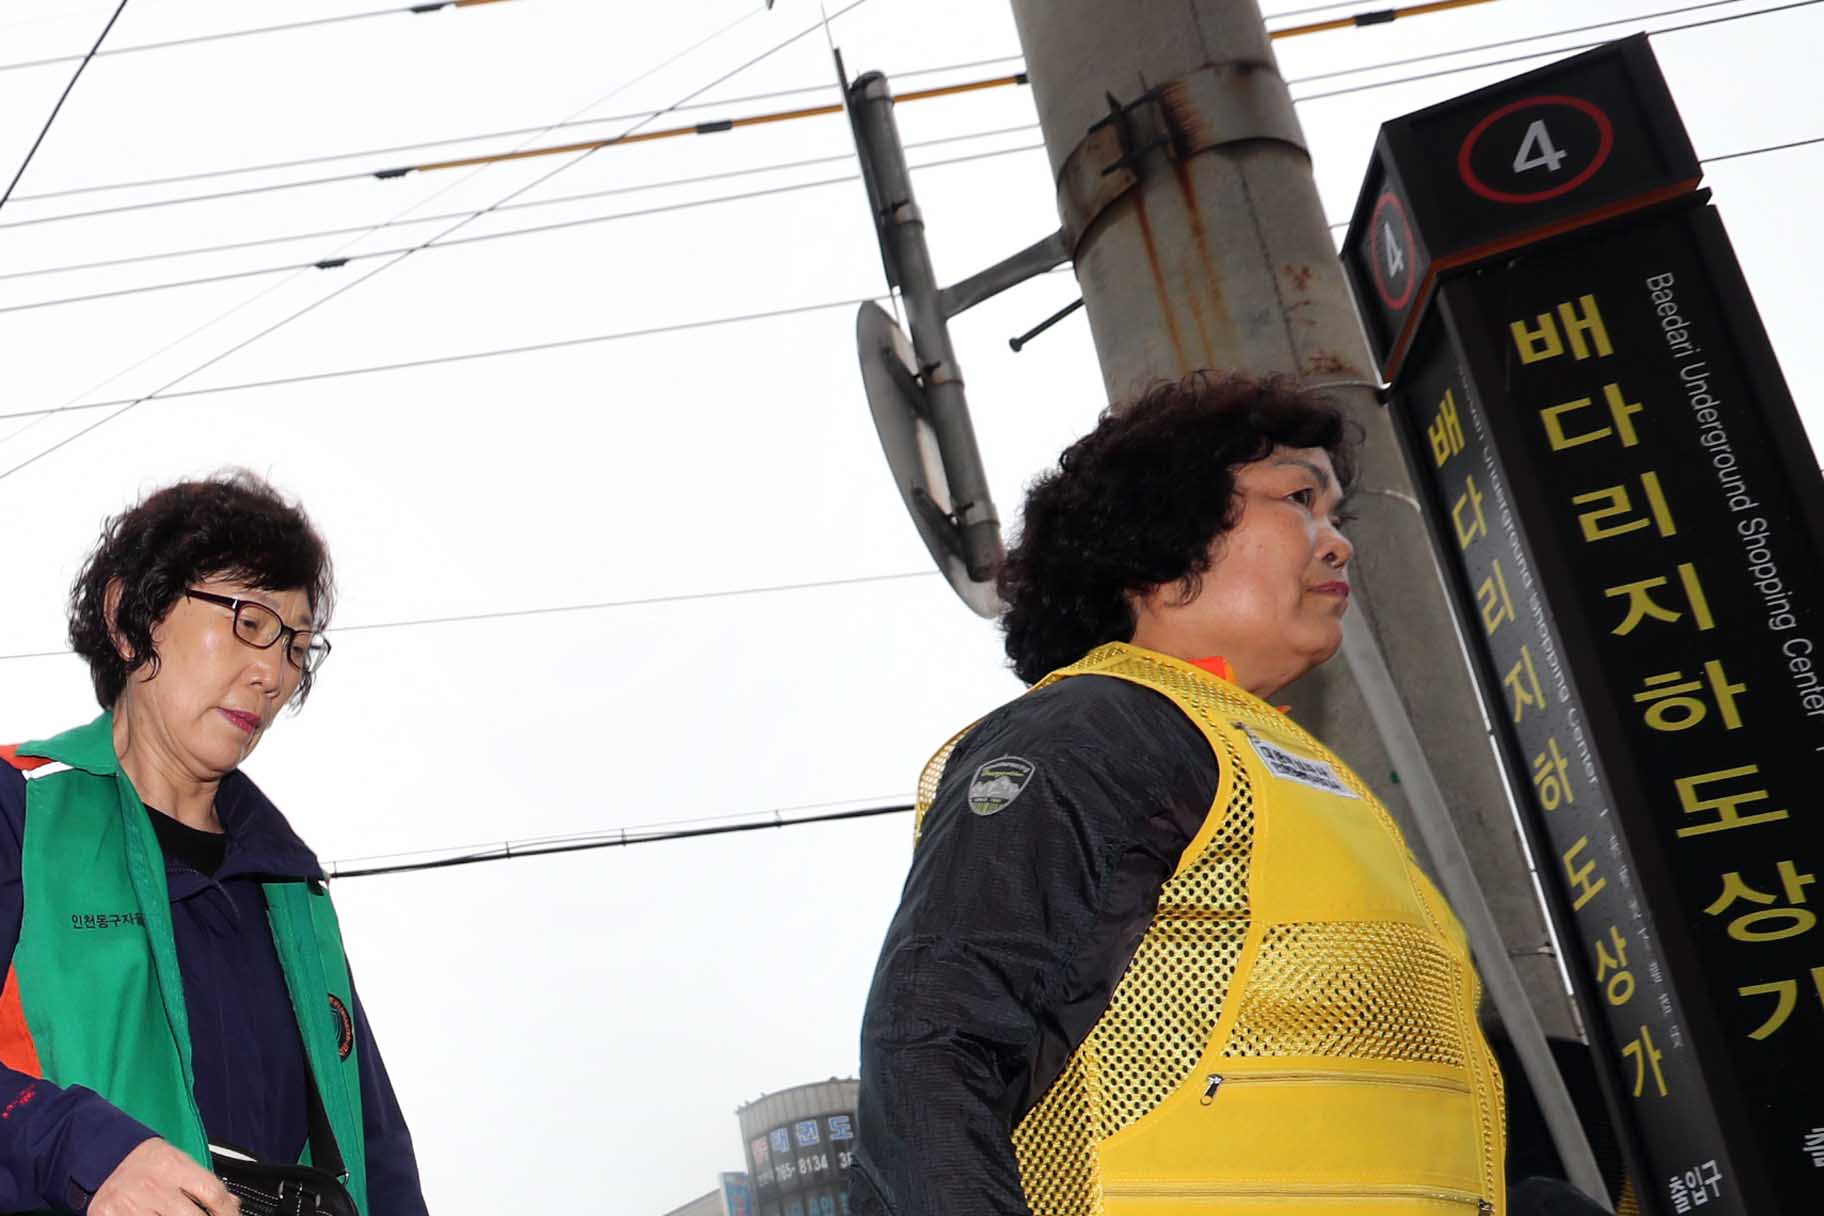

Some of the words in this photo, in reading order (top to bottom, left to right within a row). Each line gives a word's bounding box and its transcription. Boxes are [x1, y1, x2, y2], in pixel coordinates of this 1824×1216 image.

[1512, 119, 1568, 174] 4
[1383, 221, 1404, 278] 4
[1647, 273, 1703, 358] Baedari
[1681, 361, 1759, 513] Underground
[1737, 516, 1797, 631] Shopping
[1428, 389, 1668, 1097] 배다리지하도상가
[1669, 1159, 1723, 1215] 출입구
